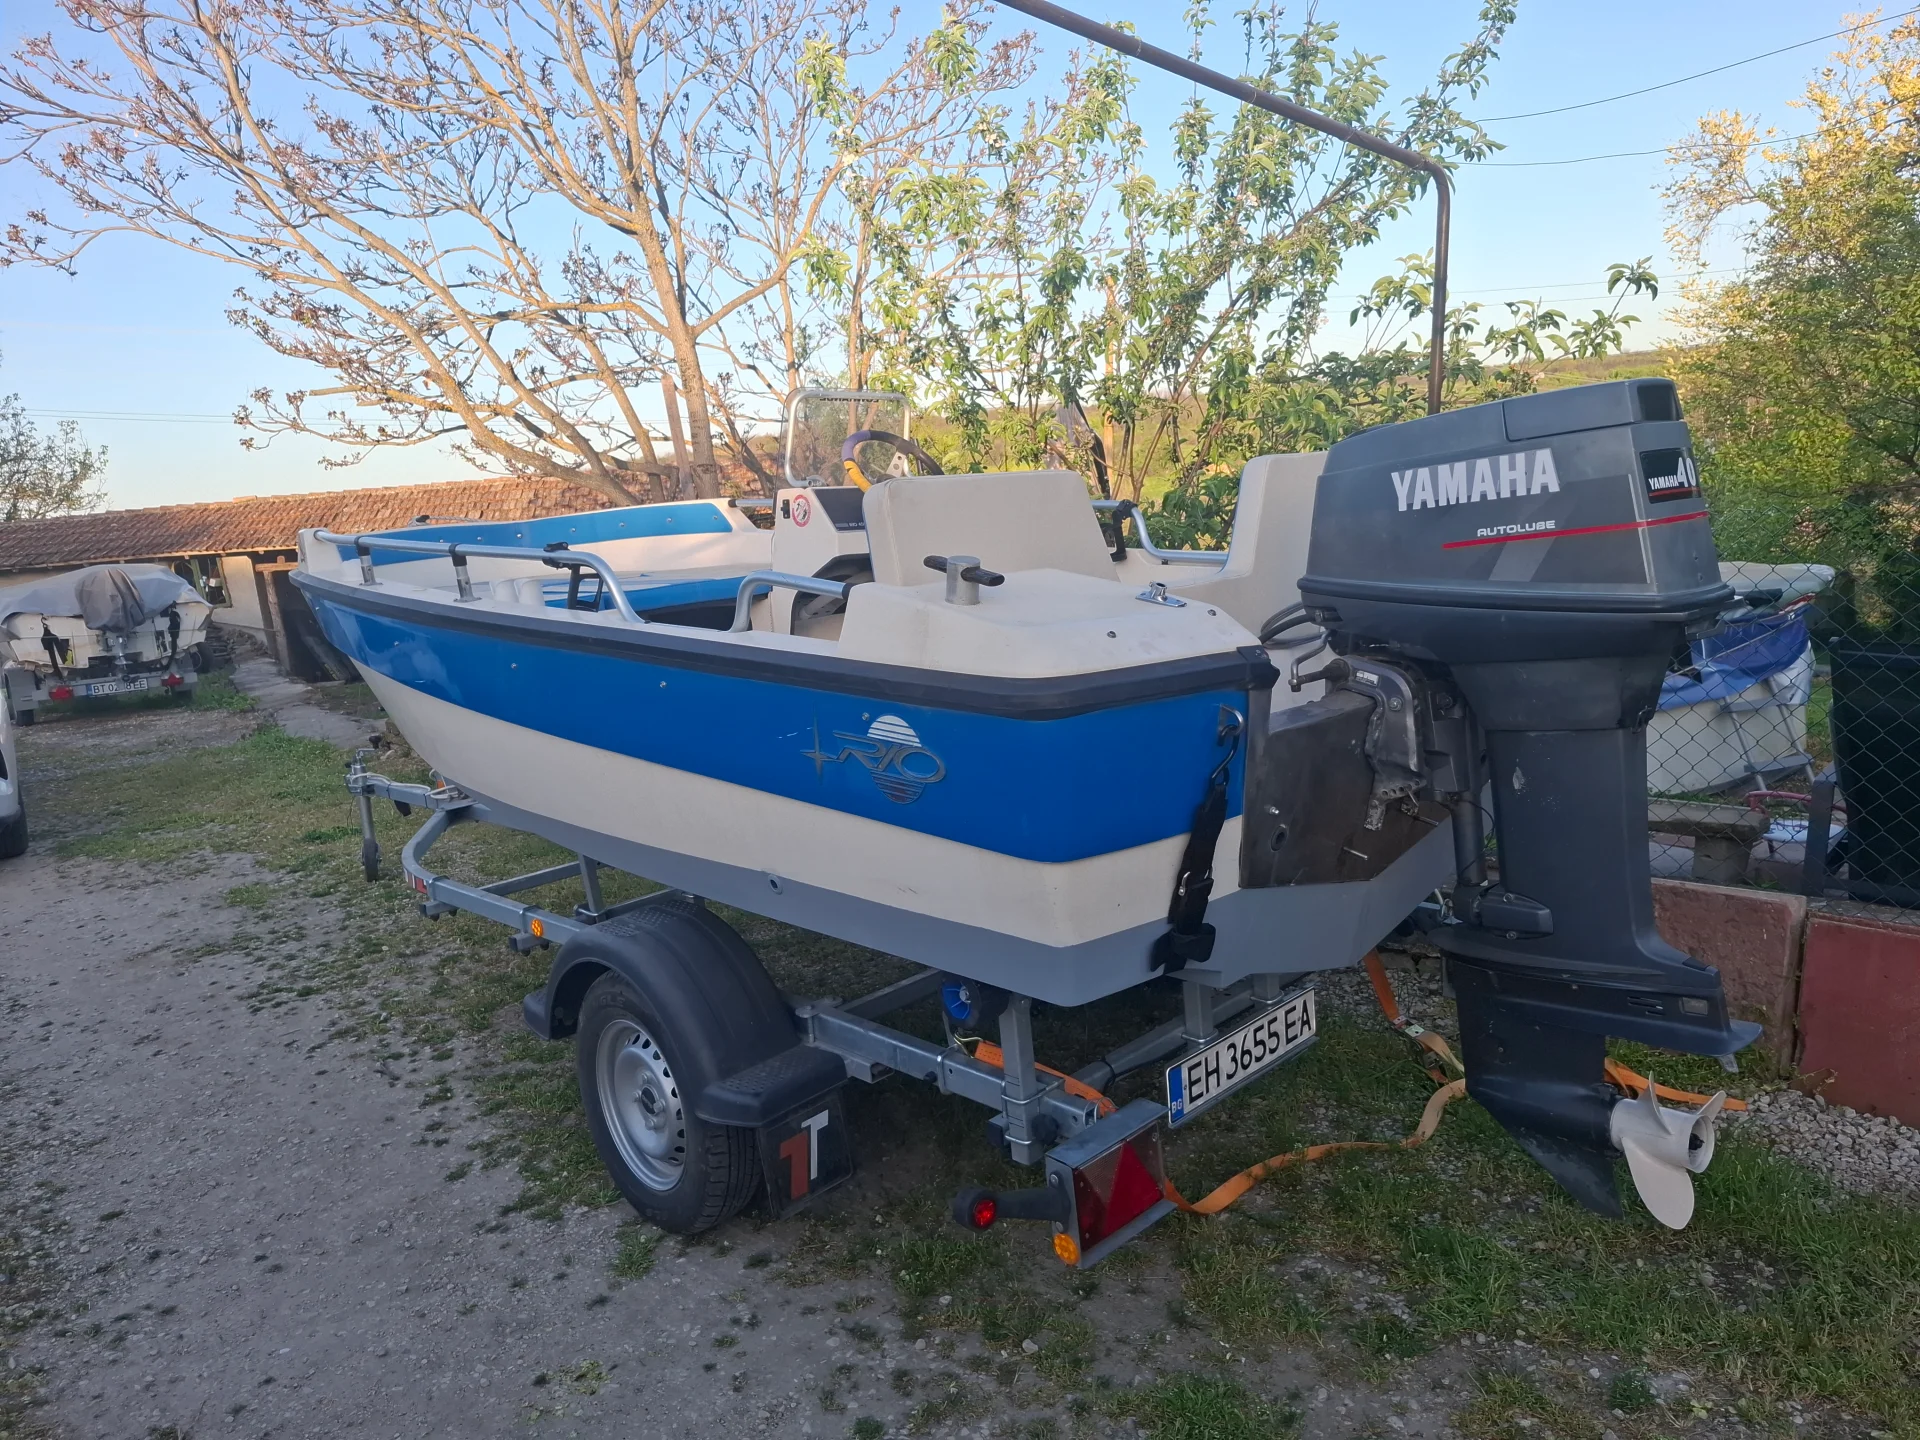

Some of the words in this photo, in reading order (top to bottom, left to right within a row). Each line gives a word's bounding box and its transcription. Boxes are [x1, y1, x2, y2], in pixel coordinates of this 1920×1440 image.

[1391, 448, 1560, 512] YAMAHA
[1648, 474, 1679, 490] YAMAHA
[1677, 456, 1697, 488] 40
[1477, 520, 1556, 537] AUTOLUBE
[1187, 1051, 1221, 1104] EH
[1225, 1016, 1280, 1081] 3655
[1284, 999, 1312, 1046] EA
[1171, 1098, 1183, 1114] BG
